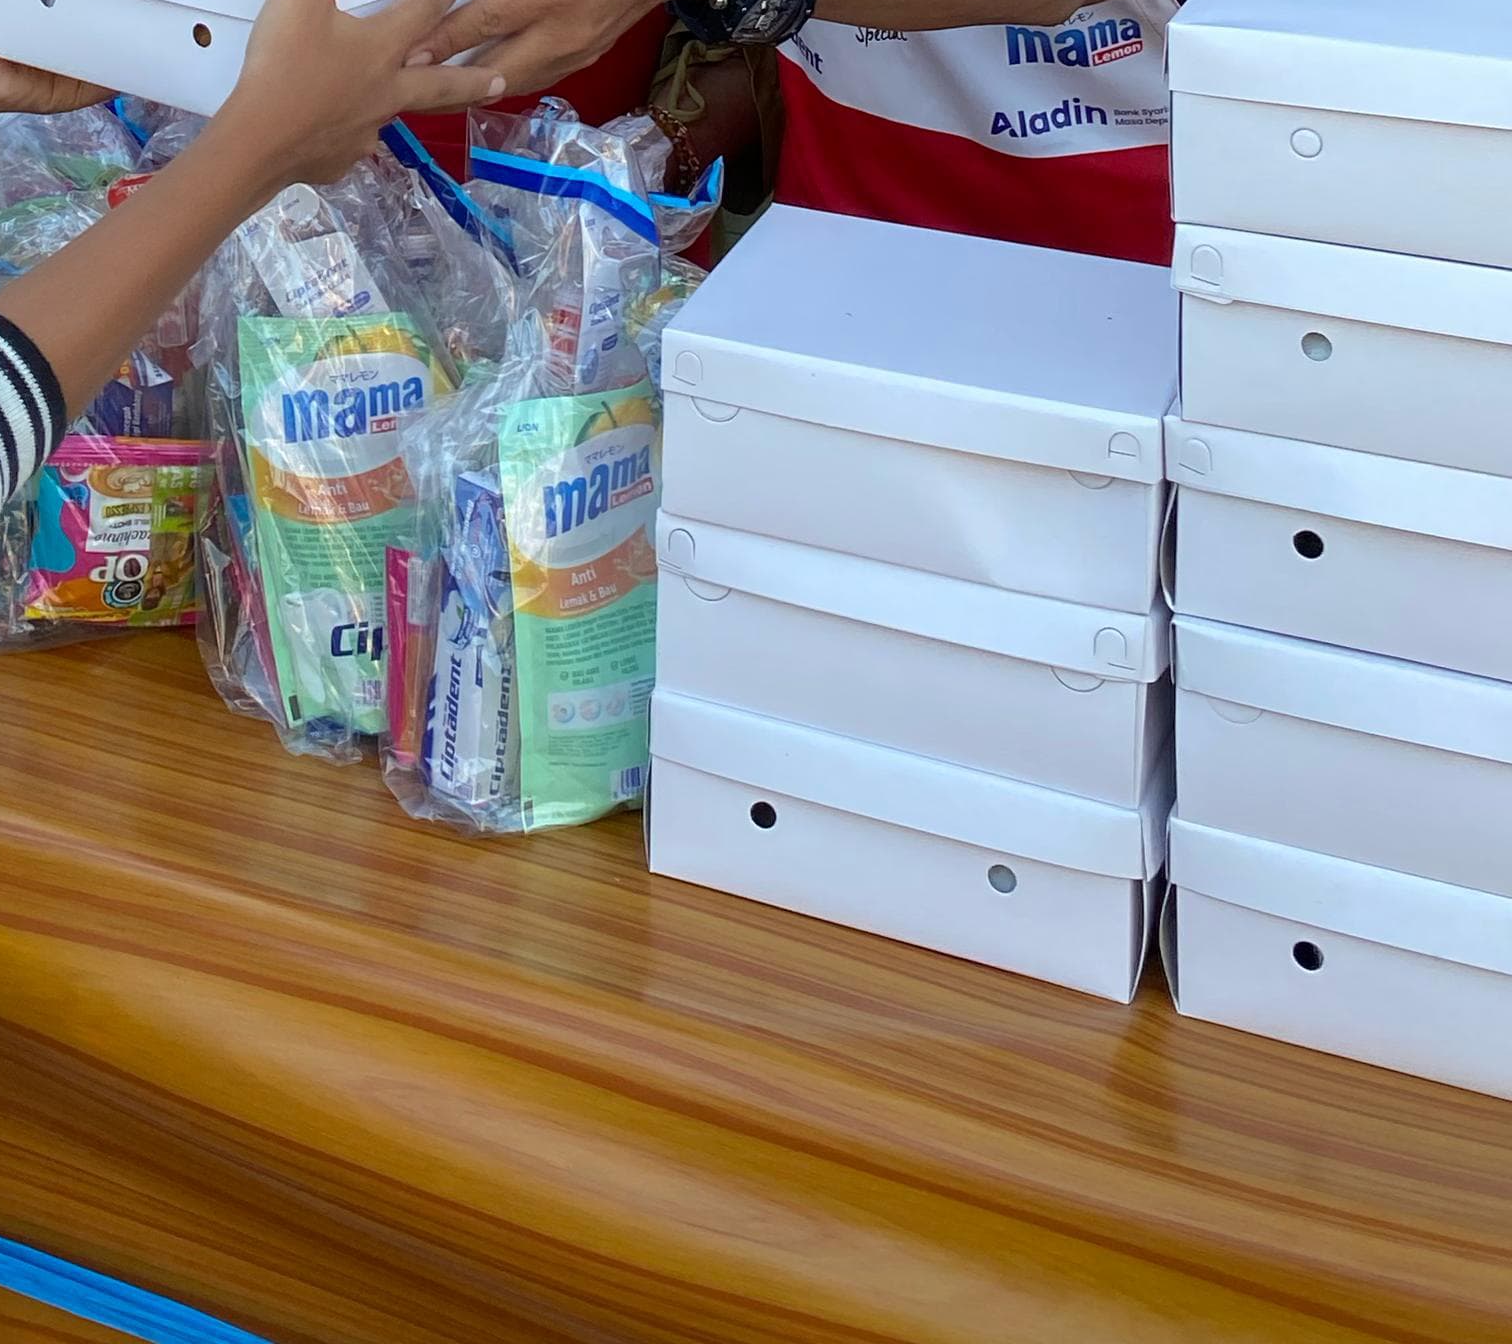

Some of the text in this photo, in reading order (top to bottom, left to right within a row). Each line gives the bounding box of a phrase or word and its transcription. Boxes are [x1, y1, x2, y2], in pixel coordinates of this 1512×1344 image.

[1005, 17, 1142, 68] mama
[1094, 42, 1141, 64] Lemon
[990, 97, 1108, 139] Aladin
[282, 376, 425, 444] mama
[317, 483, 348, 497] Anti
[347, 500, 370, 513] Bau
[543, 444, 651, 540] mama
[570, 566, 597, 587] Anti
[559, 583, 617, 610] Lemak & Bau
[440, 655, 463, 781] Ciptadent
